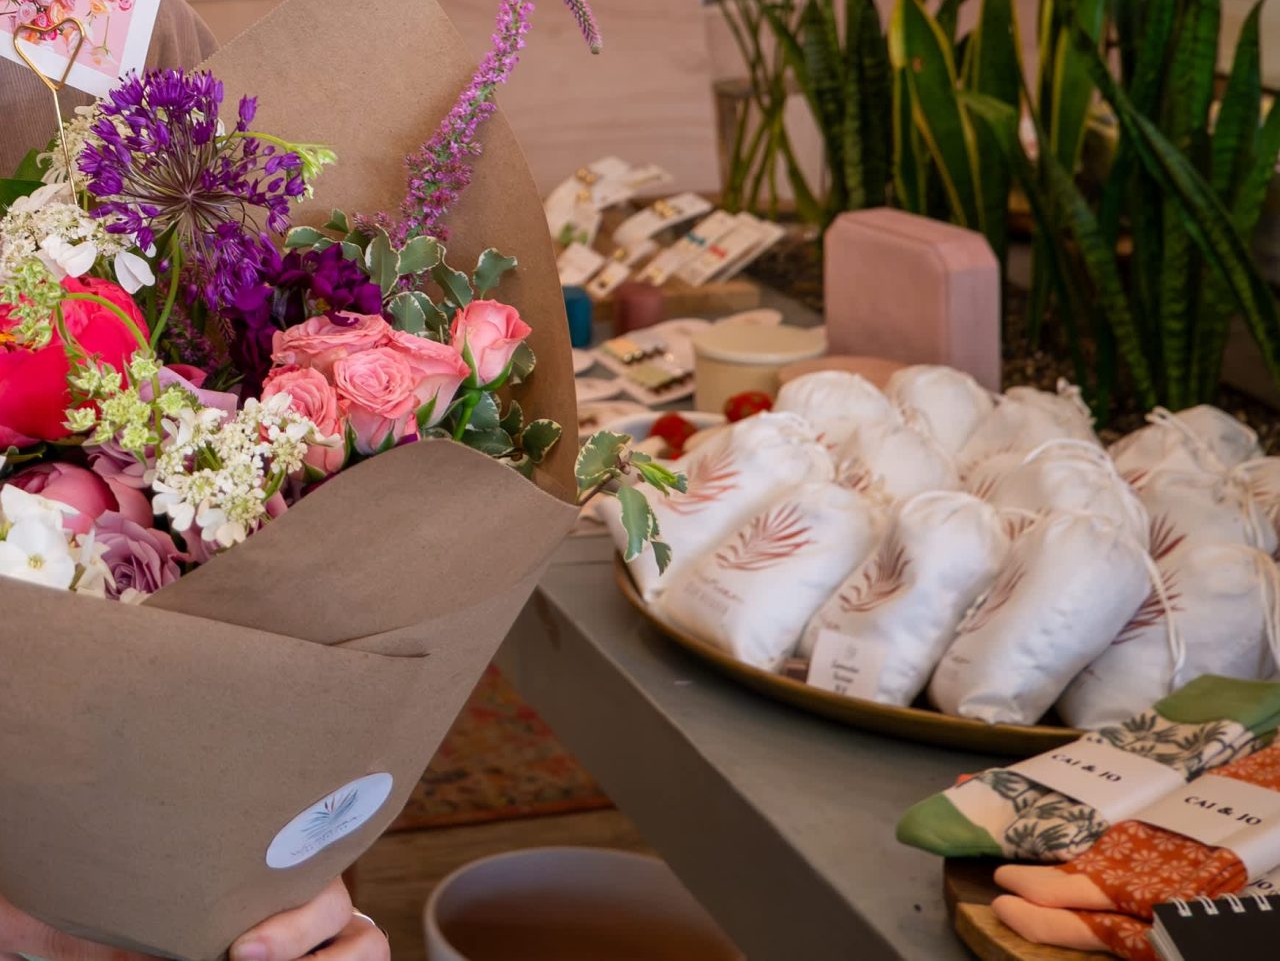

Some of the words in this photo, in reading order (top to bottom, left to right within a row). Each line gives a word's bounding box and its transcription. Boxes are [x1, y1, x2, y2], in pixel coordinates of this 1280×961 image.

[1051, 753, 1081, 766] CAI
[1098, 770, 1122, 782] JO
[1183, 795, 1217, 809] CAI
[1216, 806, 1234, 816] &
[1235, 813, 1263, 826] JO
